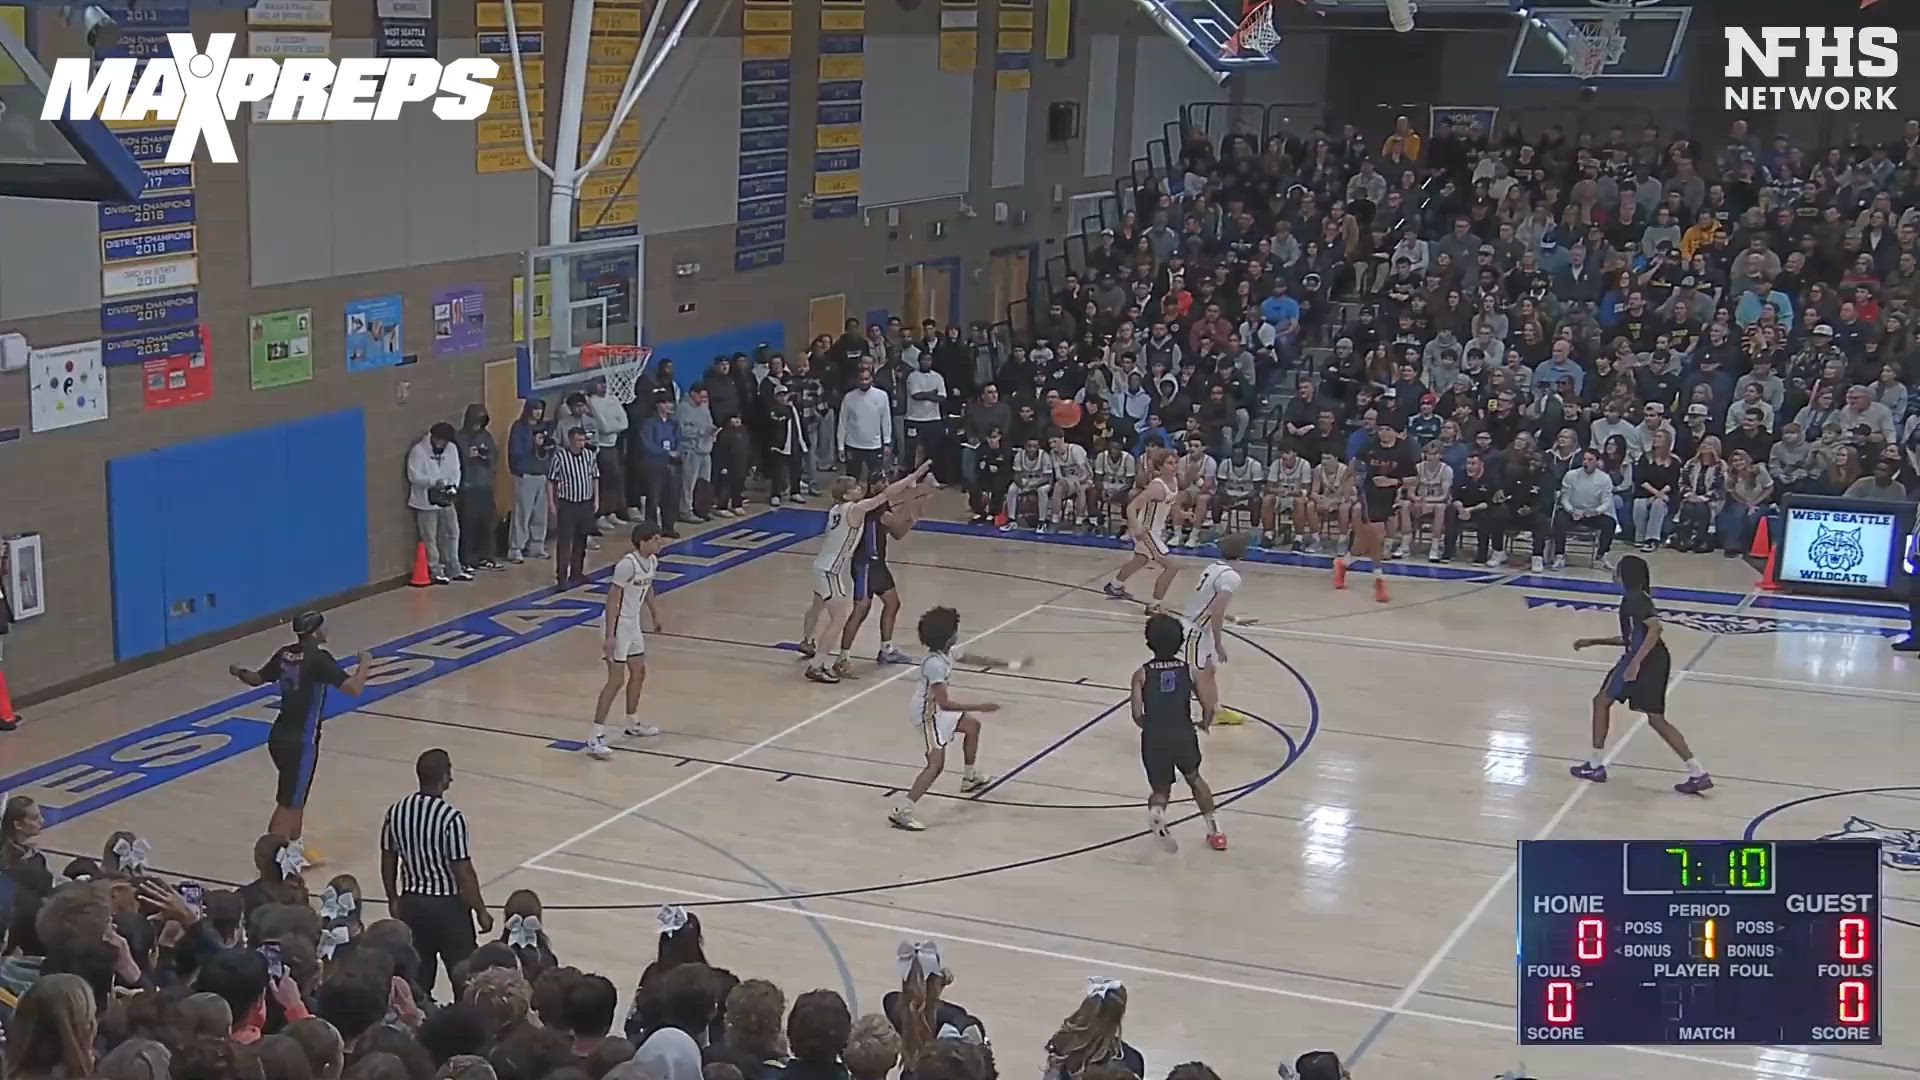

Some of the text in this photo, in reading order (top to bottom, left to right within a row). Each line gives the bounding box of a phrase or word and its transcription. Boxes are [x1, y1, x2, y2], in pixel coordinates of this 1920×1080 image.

[384, 28, 425, 37] WEST SEATTLE
[401, 39, 424, 47] SCHOOL
[128, 44, 159, 55] 2014
[133, 144, 162, 155] 2016
[144, 178, 162, 188] 17
[104, 200, 192, 216] DIVISION CHAMPIONS
[134, 210, 164, 222] 2018
[106, 232, 192, 249] DISTRICT CHAMPIONS
[135, 243, 166, 255] 2018
[107, 297, 194, 316] DIVISION CHAMPIONS
[137, 309, 167, 321] 2019
[107, 330, 195, 351] DIVISION CHAMPIONS
[1792, 510, 1890, 526] WEST SEATTLE
[1799, 569, 1868, 583] WILDCATS
